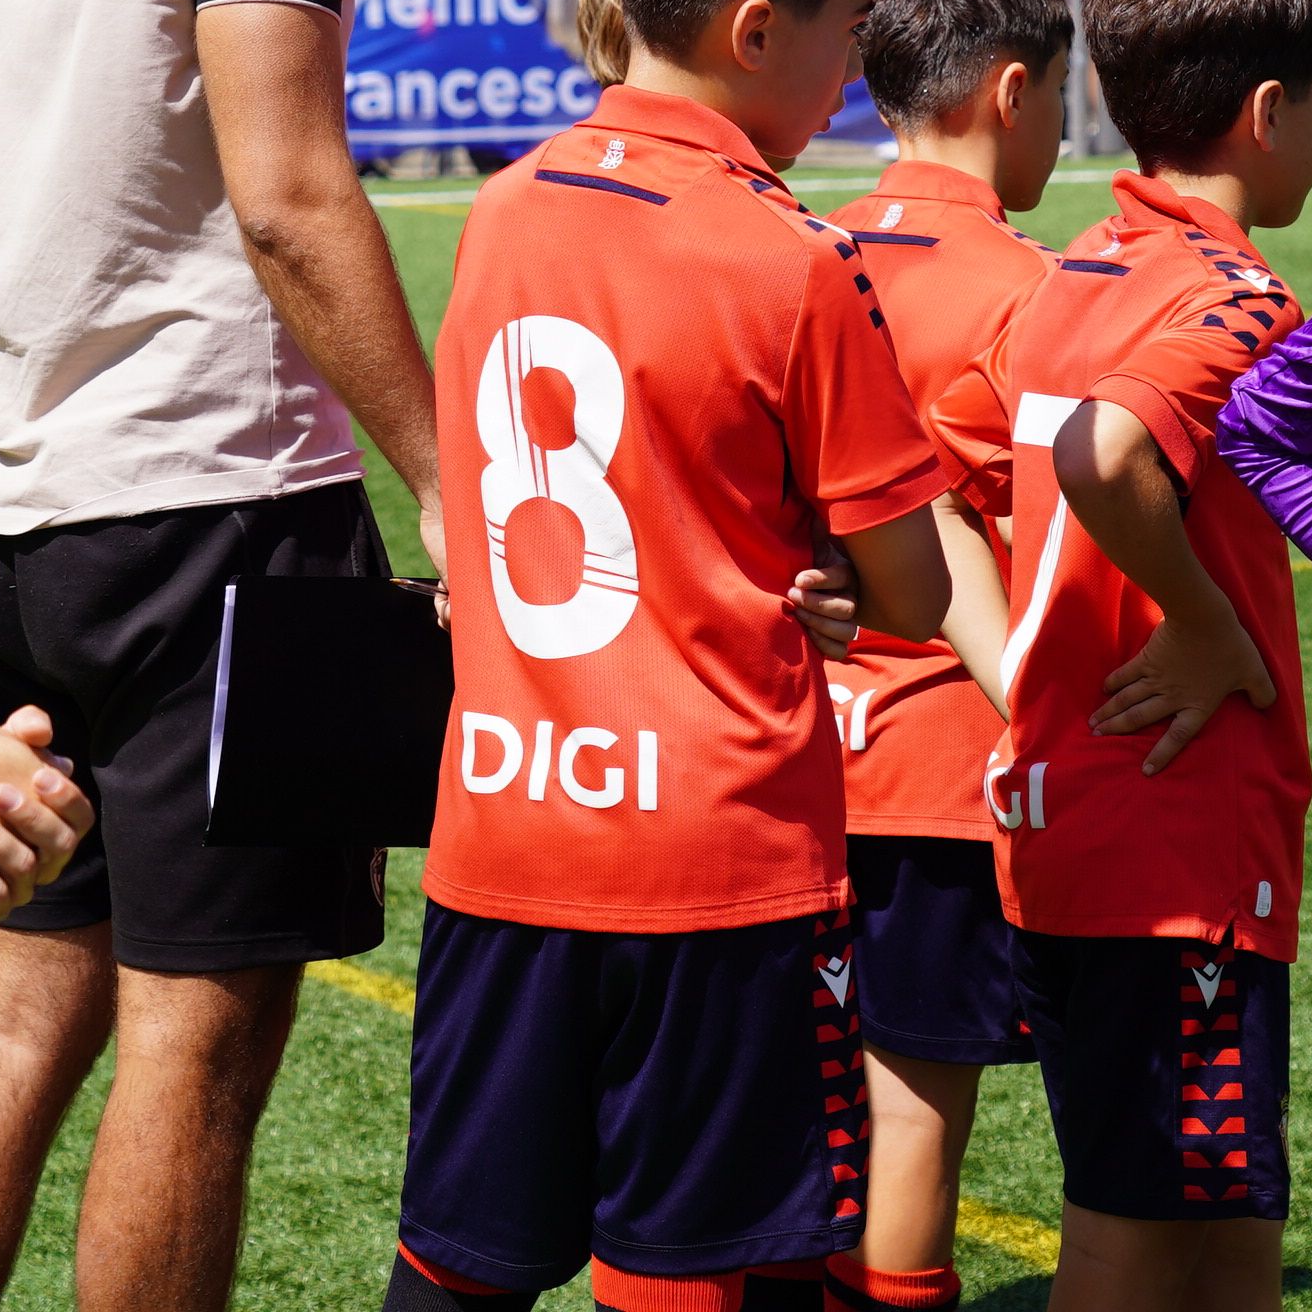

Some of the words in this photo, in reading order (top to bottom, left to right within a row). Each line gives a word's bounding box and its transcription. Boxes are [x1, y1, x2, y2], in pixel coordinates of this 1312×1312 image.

[346, 66, 597, 122] ancesc
[475, 315, 640, 660] 8
[461, 711, 658, 811] DIGI
[984, 751, 1049, 830] GI
